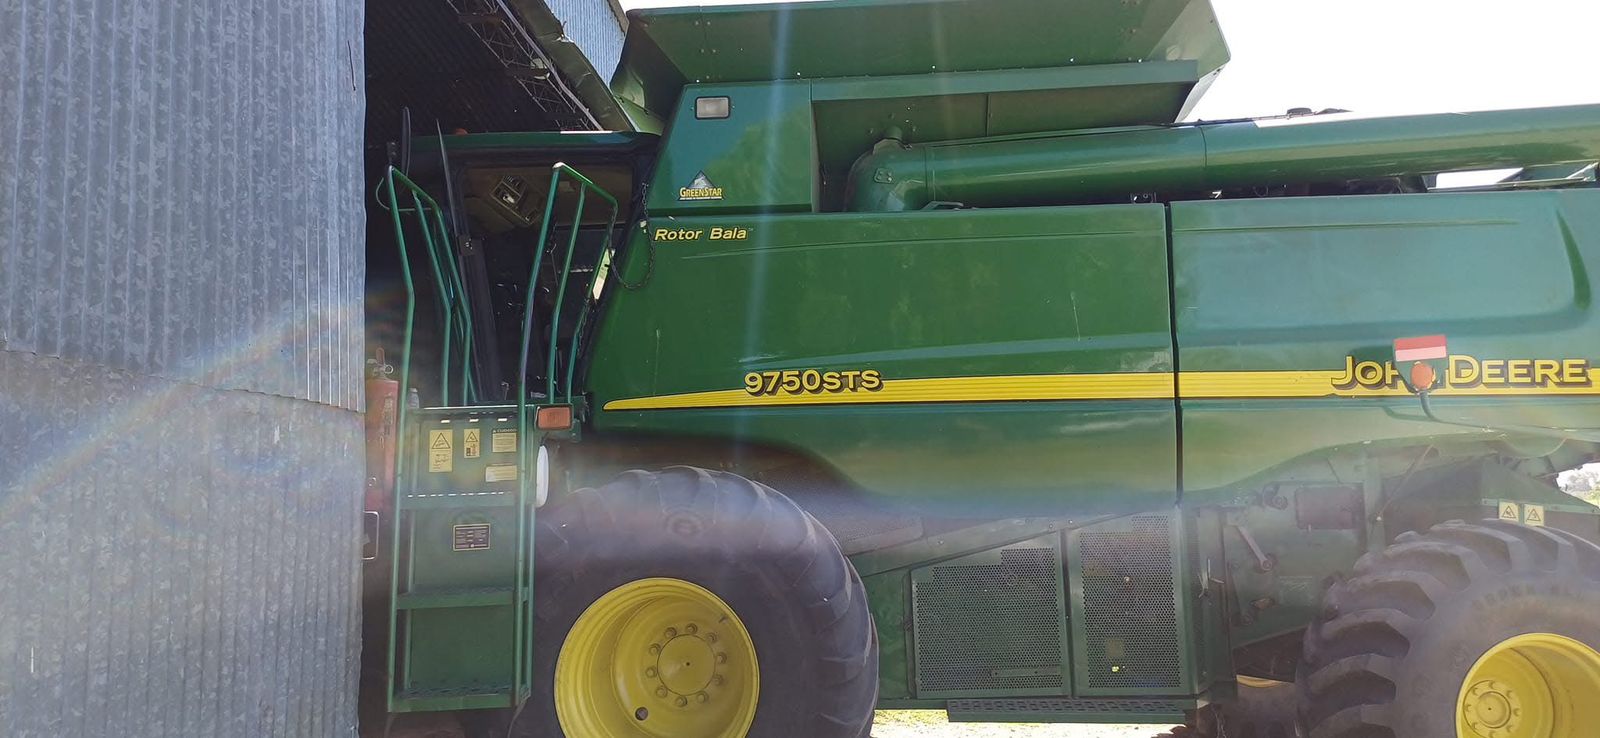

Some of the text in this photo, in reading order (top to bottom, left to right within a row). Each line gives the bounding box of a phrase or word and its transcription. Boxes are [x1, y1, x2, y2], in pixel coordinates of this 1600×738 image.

[654, 227, 748, 241] Rotor Bala
[744, 369, 883, 397] 9750STS
[1331, 354, 1592, 389] JOH DEERE
